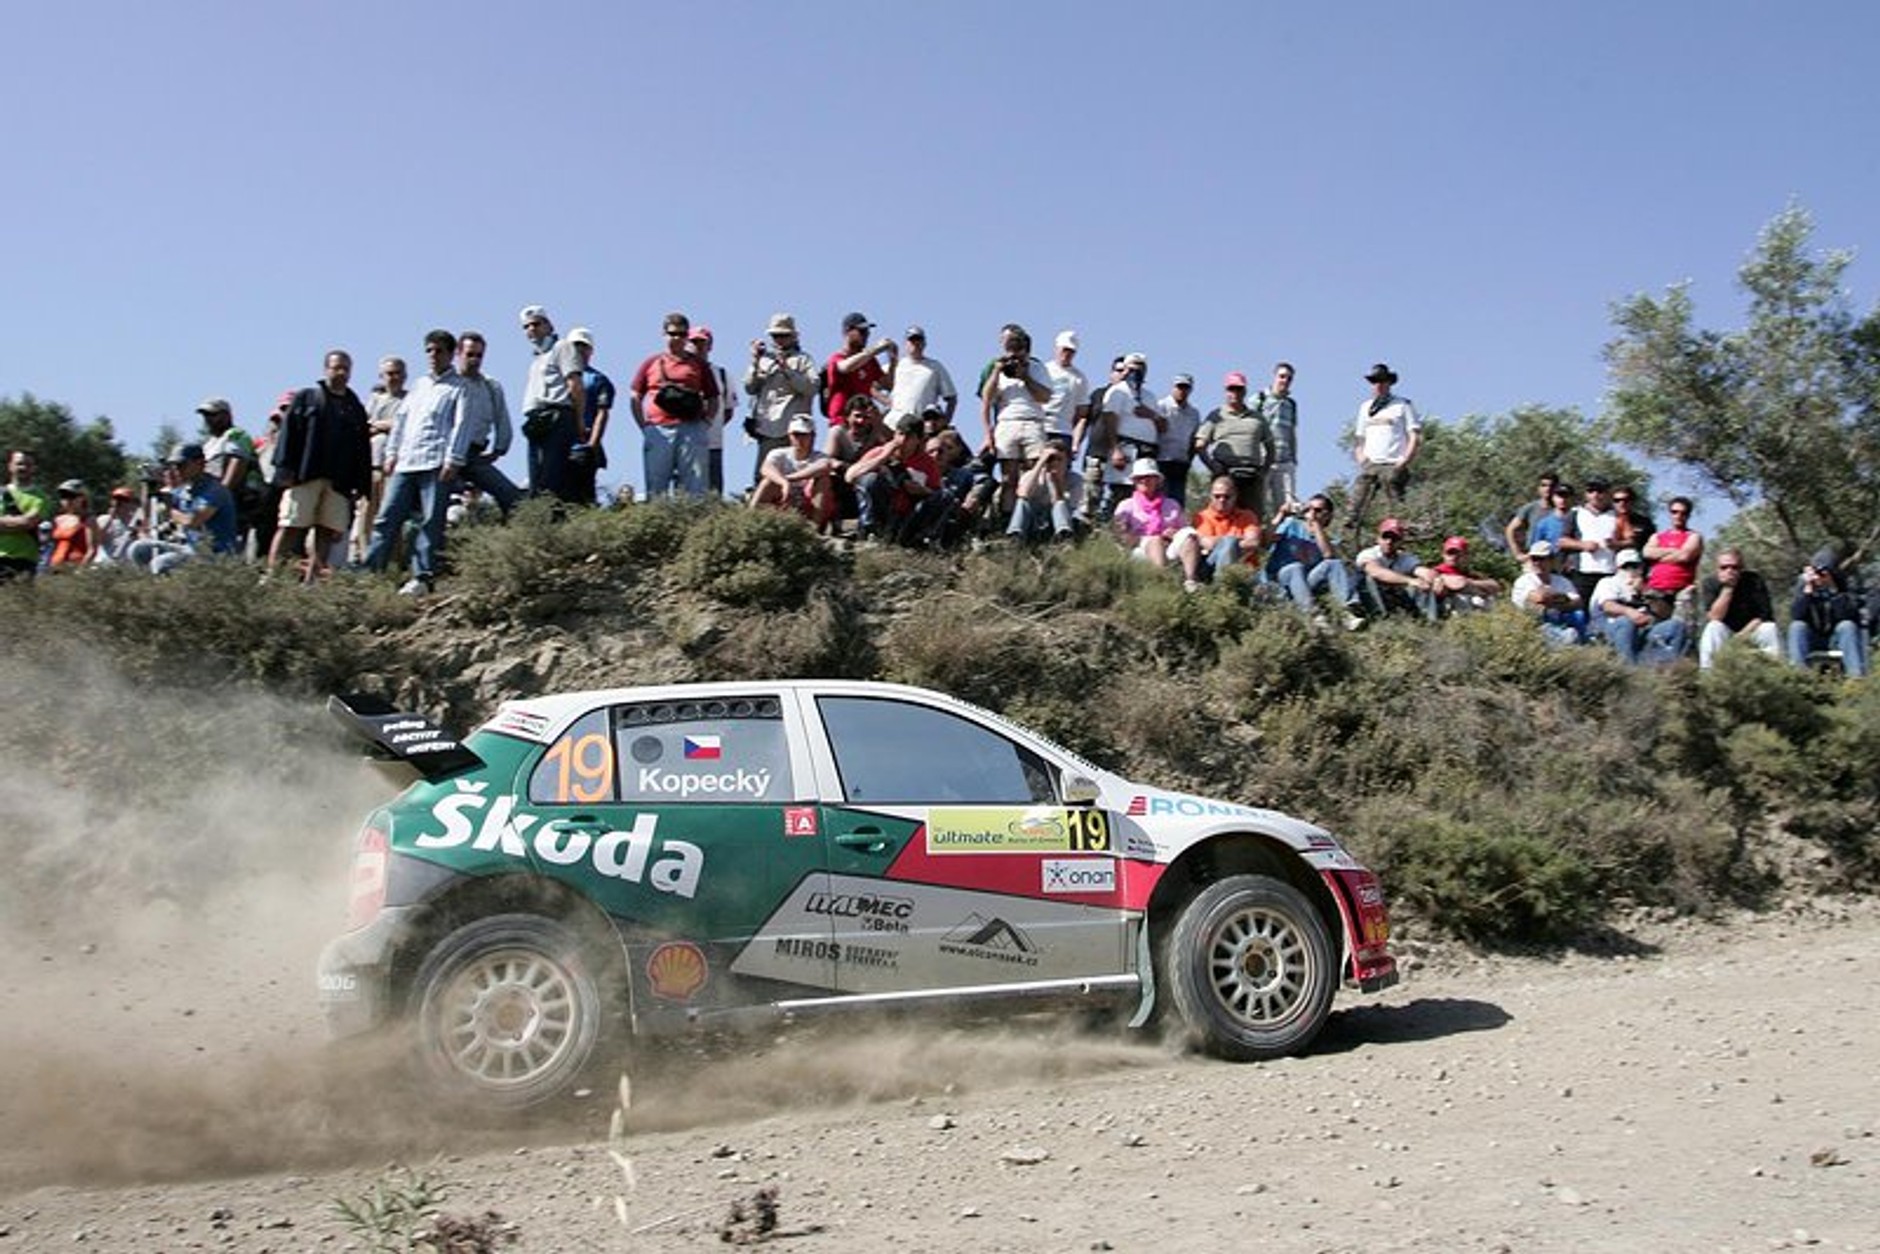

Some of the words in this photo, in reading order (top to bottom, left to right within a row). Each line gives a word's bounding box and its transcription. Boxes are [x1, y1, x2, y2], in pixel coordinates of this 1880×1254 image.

[546, 733, 614, 803] 19
[638, 768, 771, 797] Kopecký
[414, 779, 705, 898] Škoda
[1068, 810, 1107, 851] 19
[775, 938, 841, 960] MIROS
